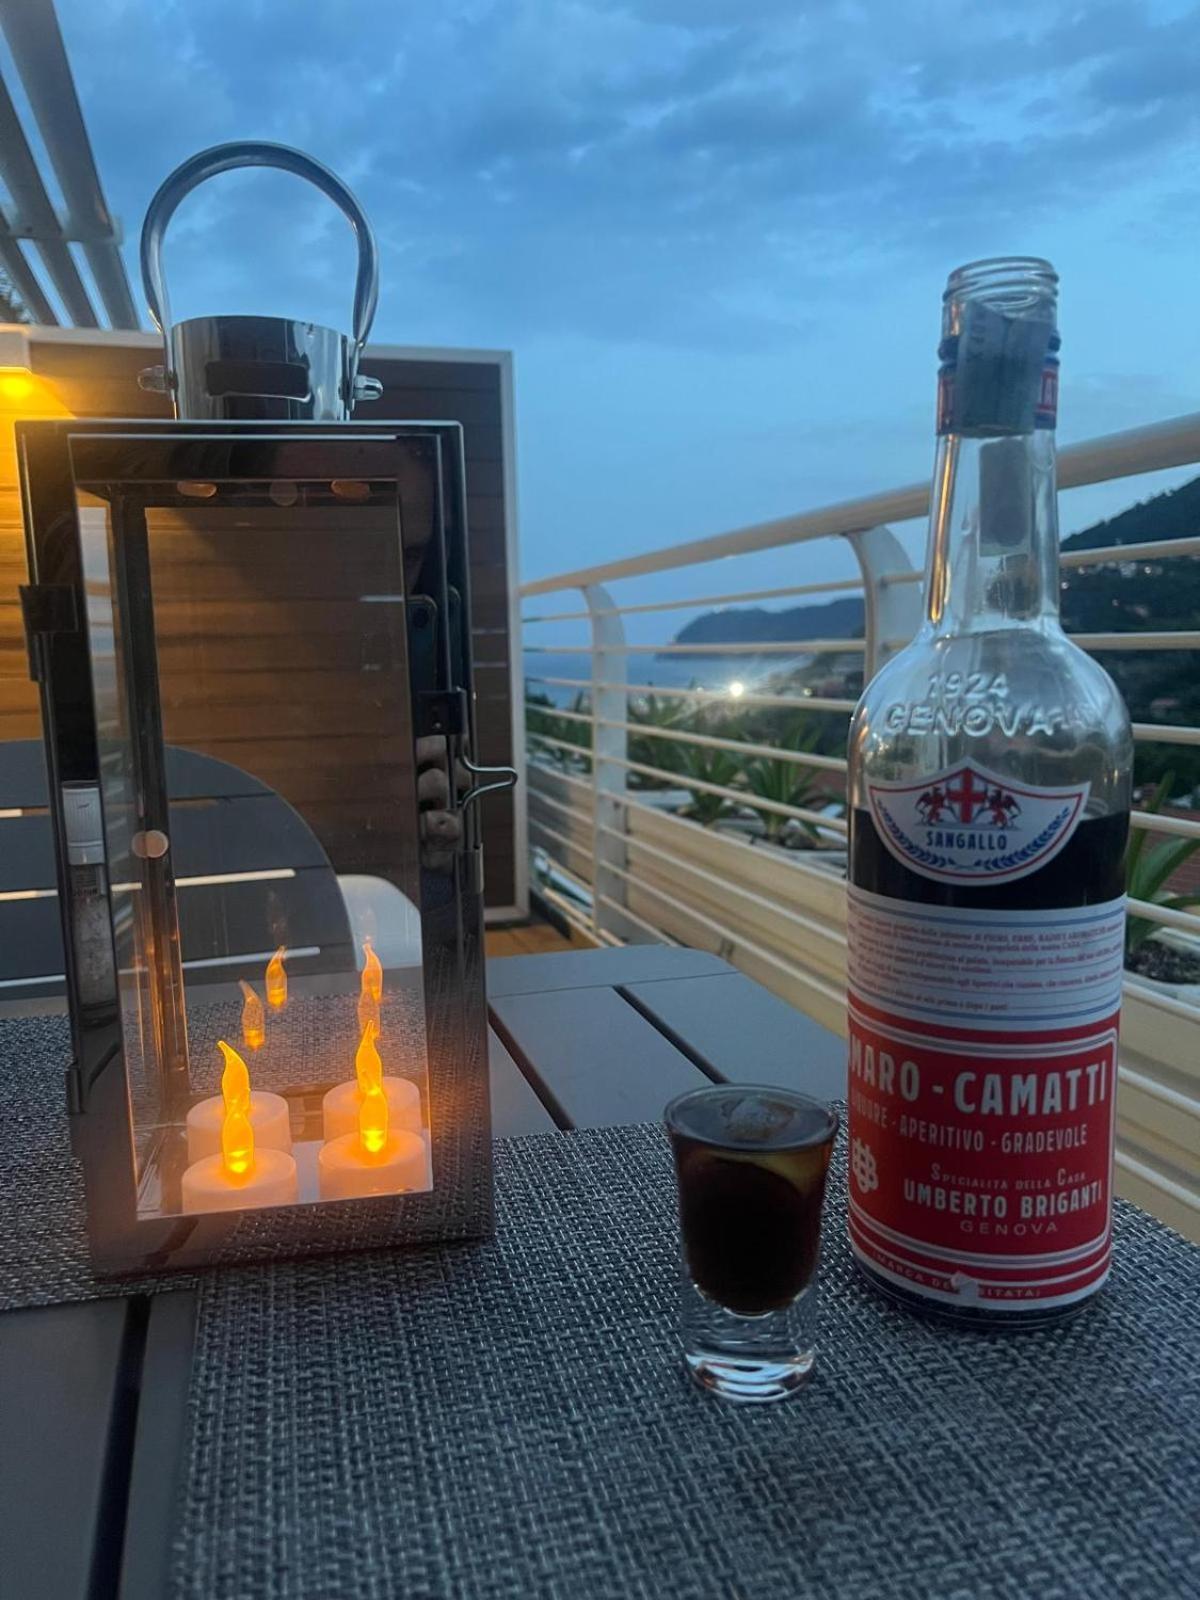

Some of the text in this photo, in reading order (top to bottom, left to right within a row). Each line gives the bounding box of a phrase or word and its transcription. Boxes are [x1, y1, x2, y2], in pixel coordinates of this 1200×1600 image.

[928, 672, 1010, 699] 1924
[885, 702, 1055, 737] GENOVA
[926, 830, 1008, 851] SANGALLO
[953, 1059, 1108, 1116] CAMATTI
[899, 1114, 984, 1151] APERITIVO
[1001, 1123, 1088, 1154] GRADEVOLE
[903, 1177, 1102, 1219] UMBERTO BRIGANTI
[959, 1219, 1059, 1236] GENOVA
